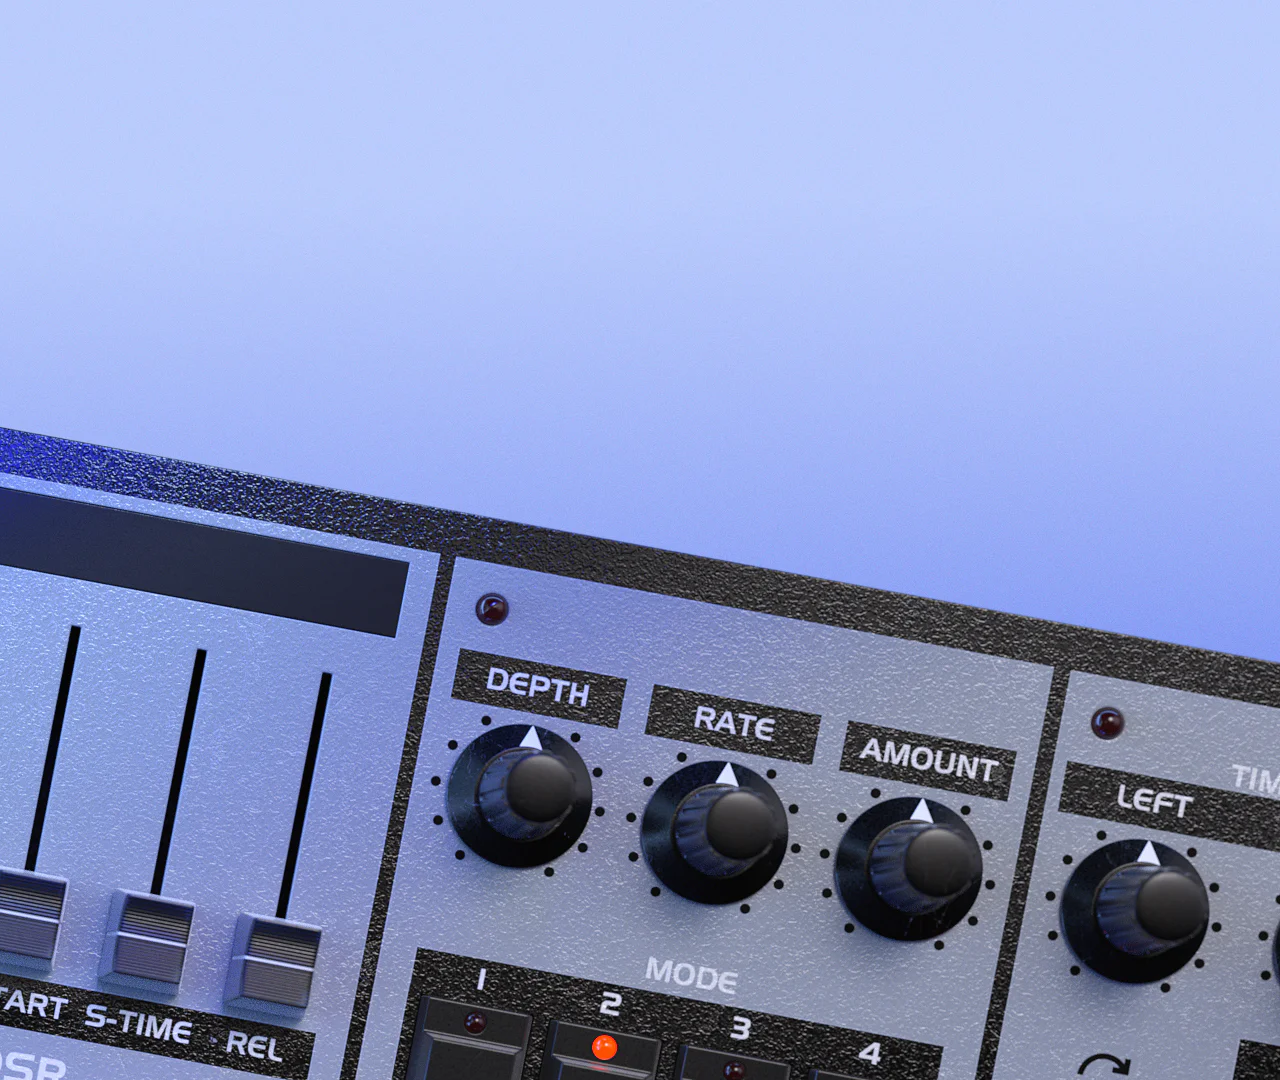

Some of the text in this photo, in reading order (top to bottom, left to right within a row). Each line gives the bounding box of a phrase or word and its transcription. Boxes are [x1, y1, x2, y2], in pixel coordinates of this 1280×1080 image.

[486, 666, 590, 708] DEPTH
[694, 705, 776, 742] RATE
[858, 737, 1000, 782] AMOUNT
[1117, 783, 1195, 819] LEFT
[476, 967, 487, 991] 1
[645, 956, 739, 995] MODE
[599, 991, 623, 1017] 2
[84, 1003, 193, 1045] S-TIME
[730, 1015, 752, 1041] 3
[225, 1030, 283, 1063] REL
[858, 1041, 882, 1066] 4
